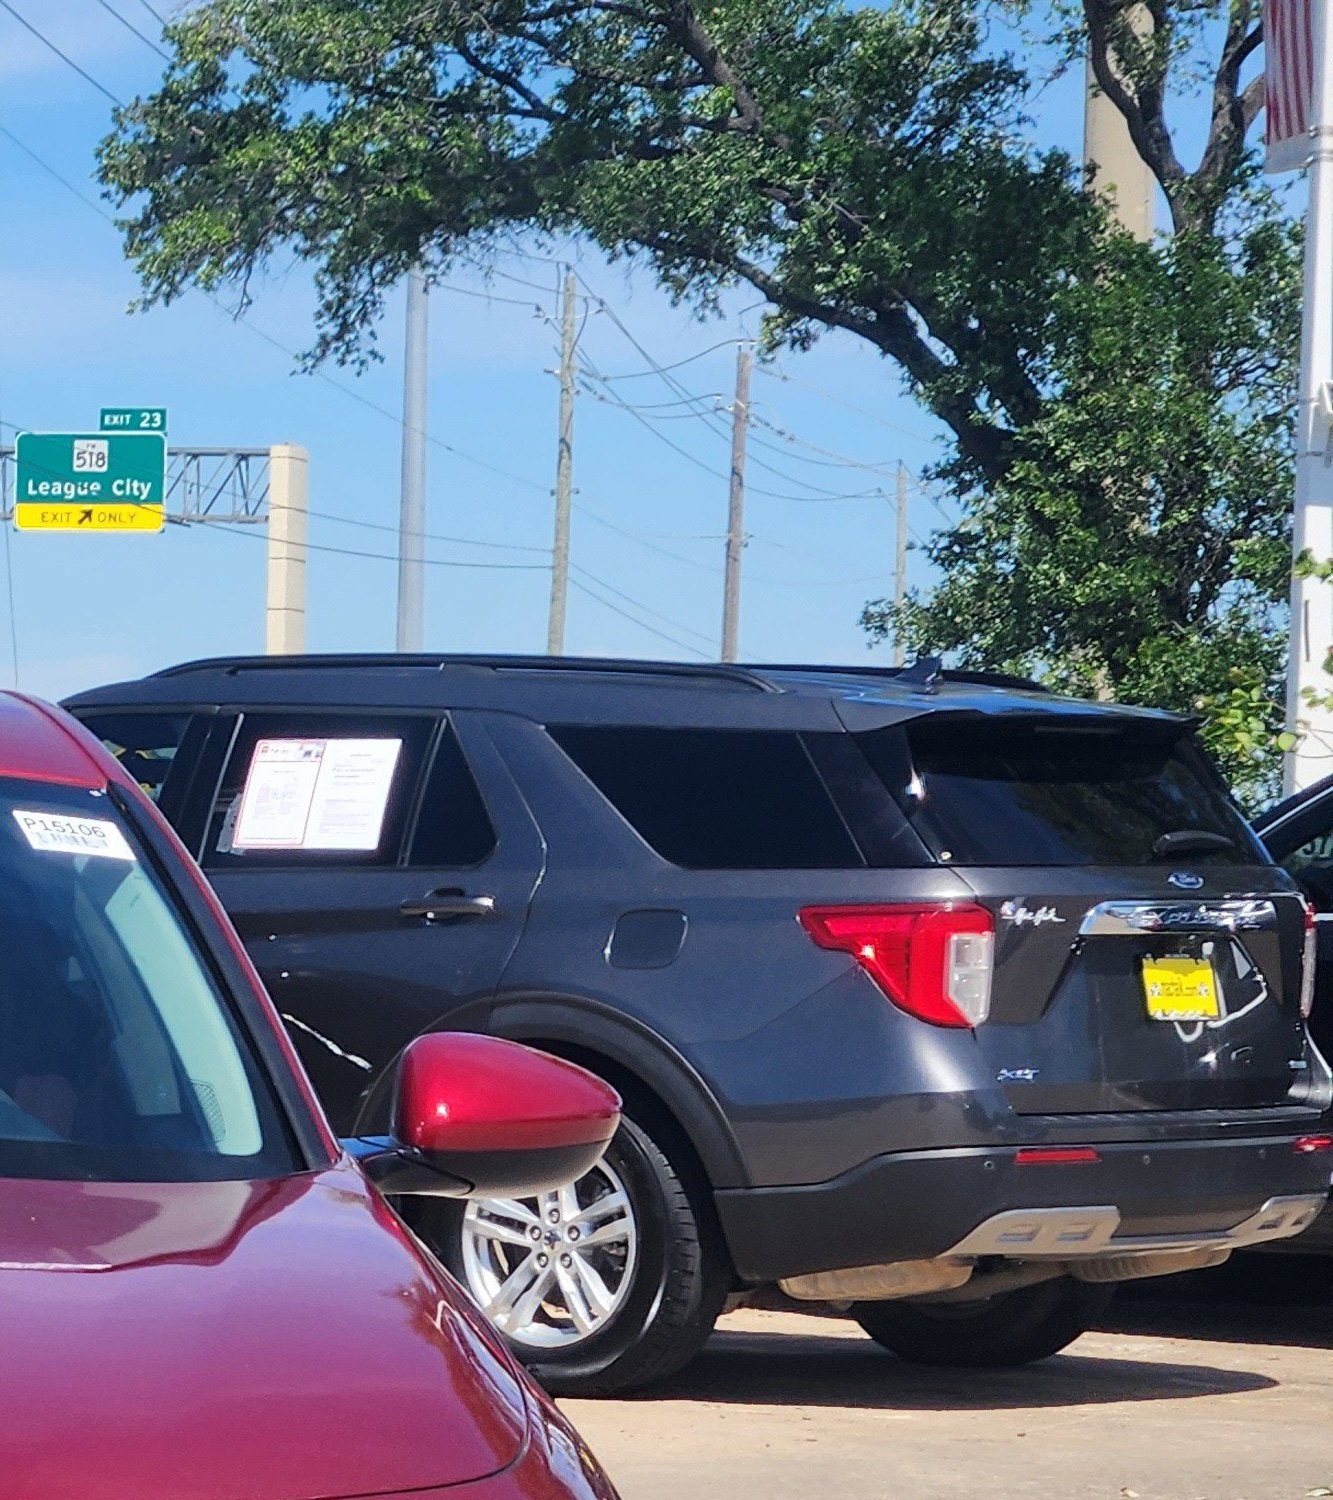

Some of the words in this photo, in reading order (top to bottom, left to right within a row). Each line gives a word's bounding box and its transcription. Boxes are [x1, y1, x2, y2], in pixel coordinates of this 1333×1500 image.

[104, 414, 132, 426] EXIT
[139, 412, 162, 428] 23
[75, 451, 106, 469] 518
[27, 479, 102, 499] League
[111, 478, 152, 500] City
[40, 511, 73, 523] EXIT
[97, 511, 137, 523] ONLY
[23, 817, 106, 838] P15106
